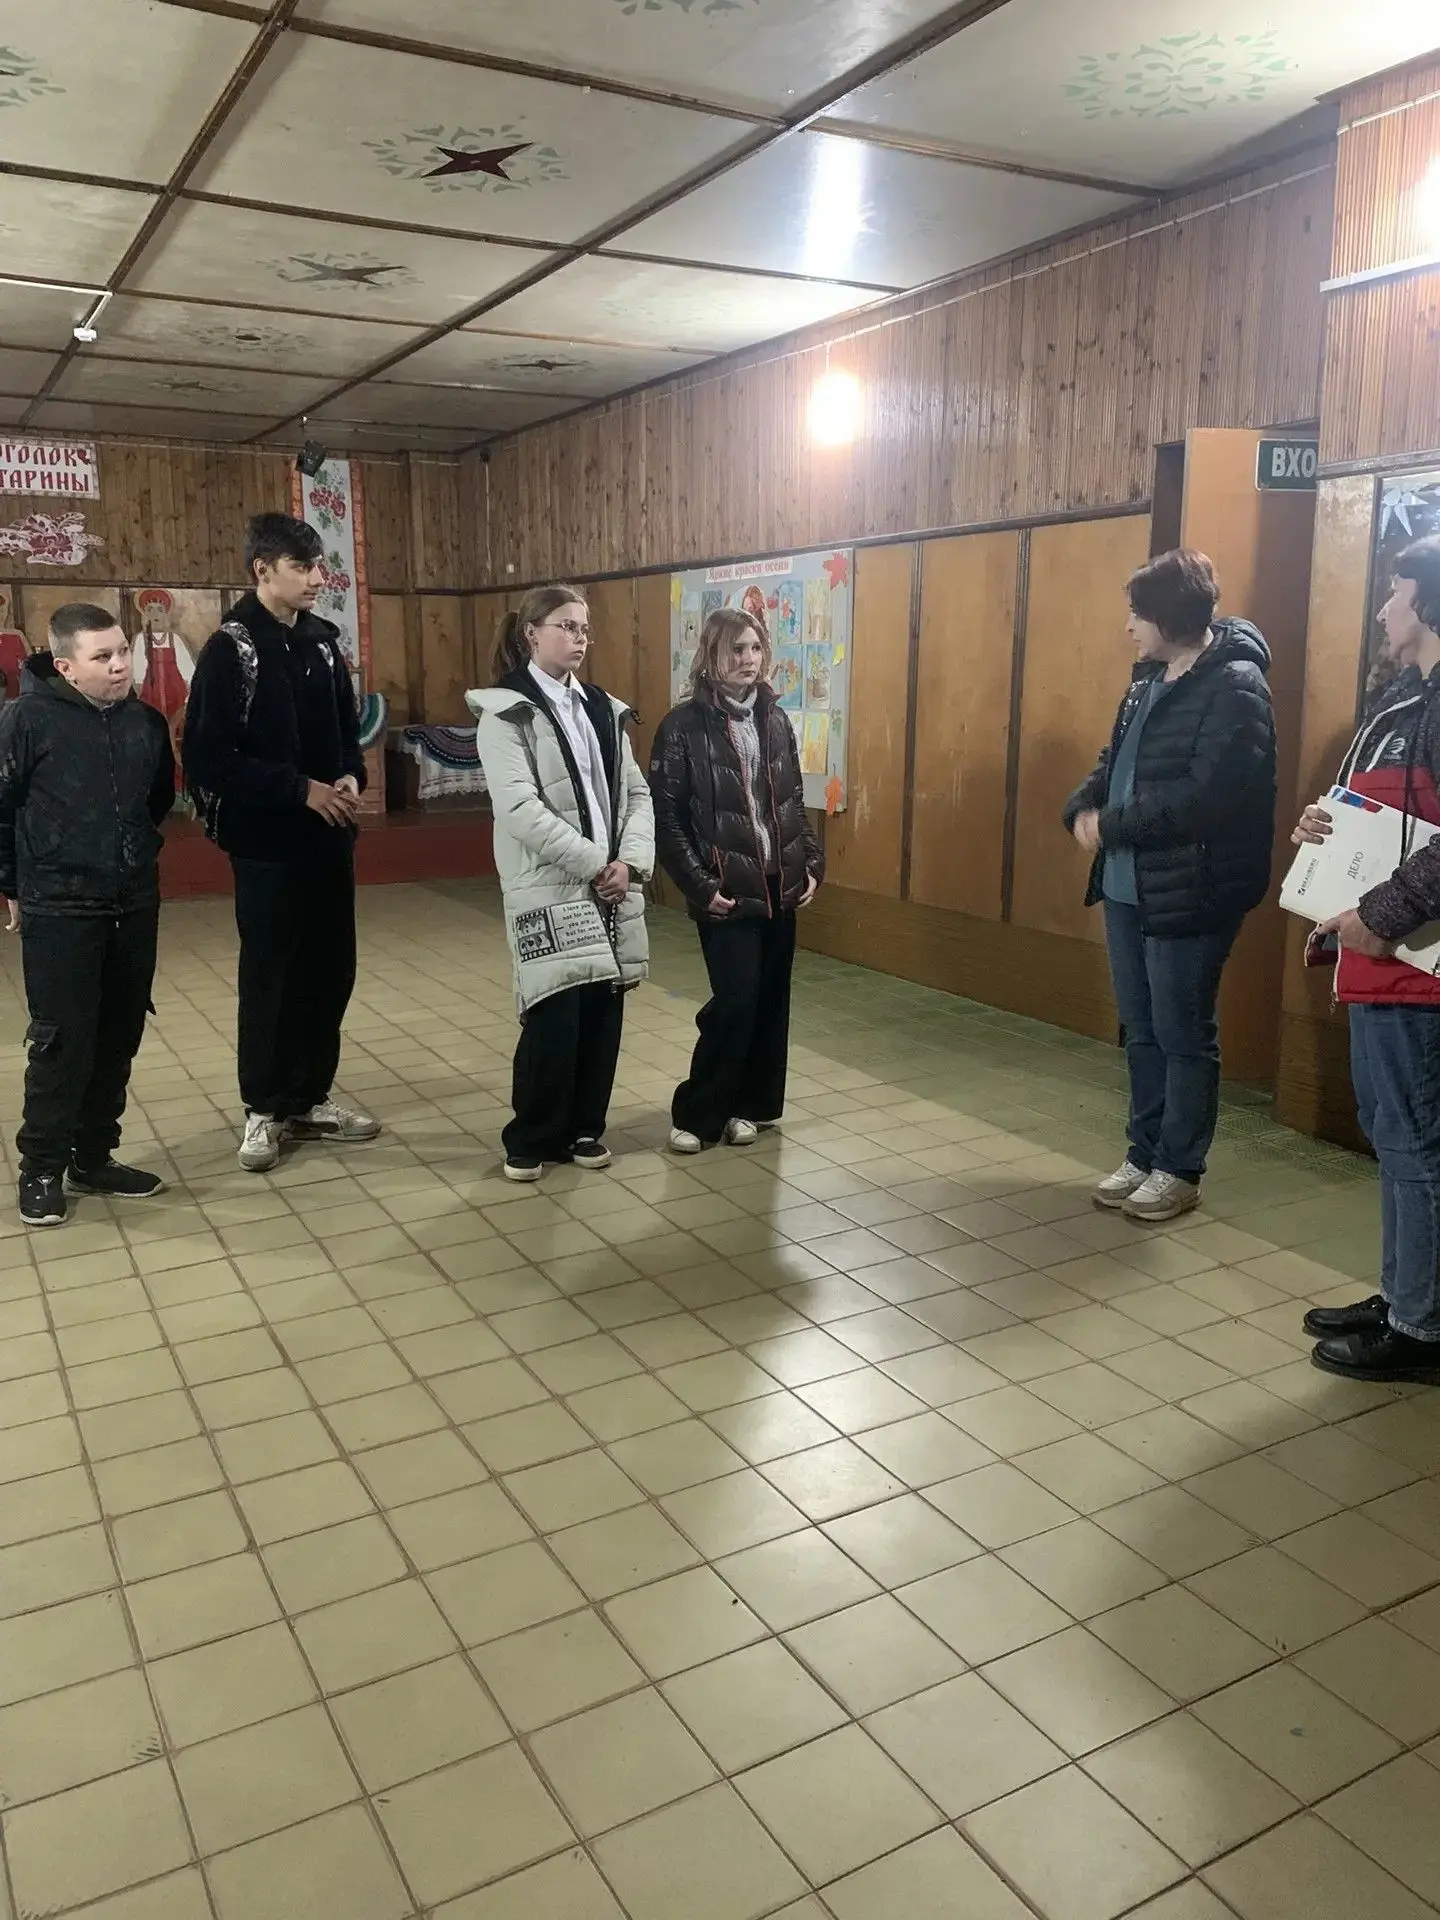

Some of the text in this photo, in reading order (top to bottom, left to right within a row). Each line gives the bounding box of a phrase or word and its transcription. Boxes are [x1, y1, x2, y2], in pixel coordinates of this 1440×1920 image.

[0, 444, 77, 467] ГОЛОК
[1271, 447, 1317, 478] ВХО
[1347, 851, 1364, 880] ДЕЛО
